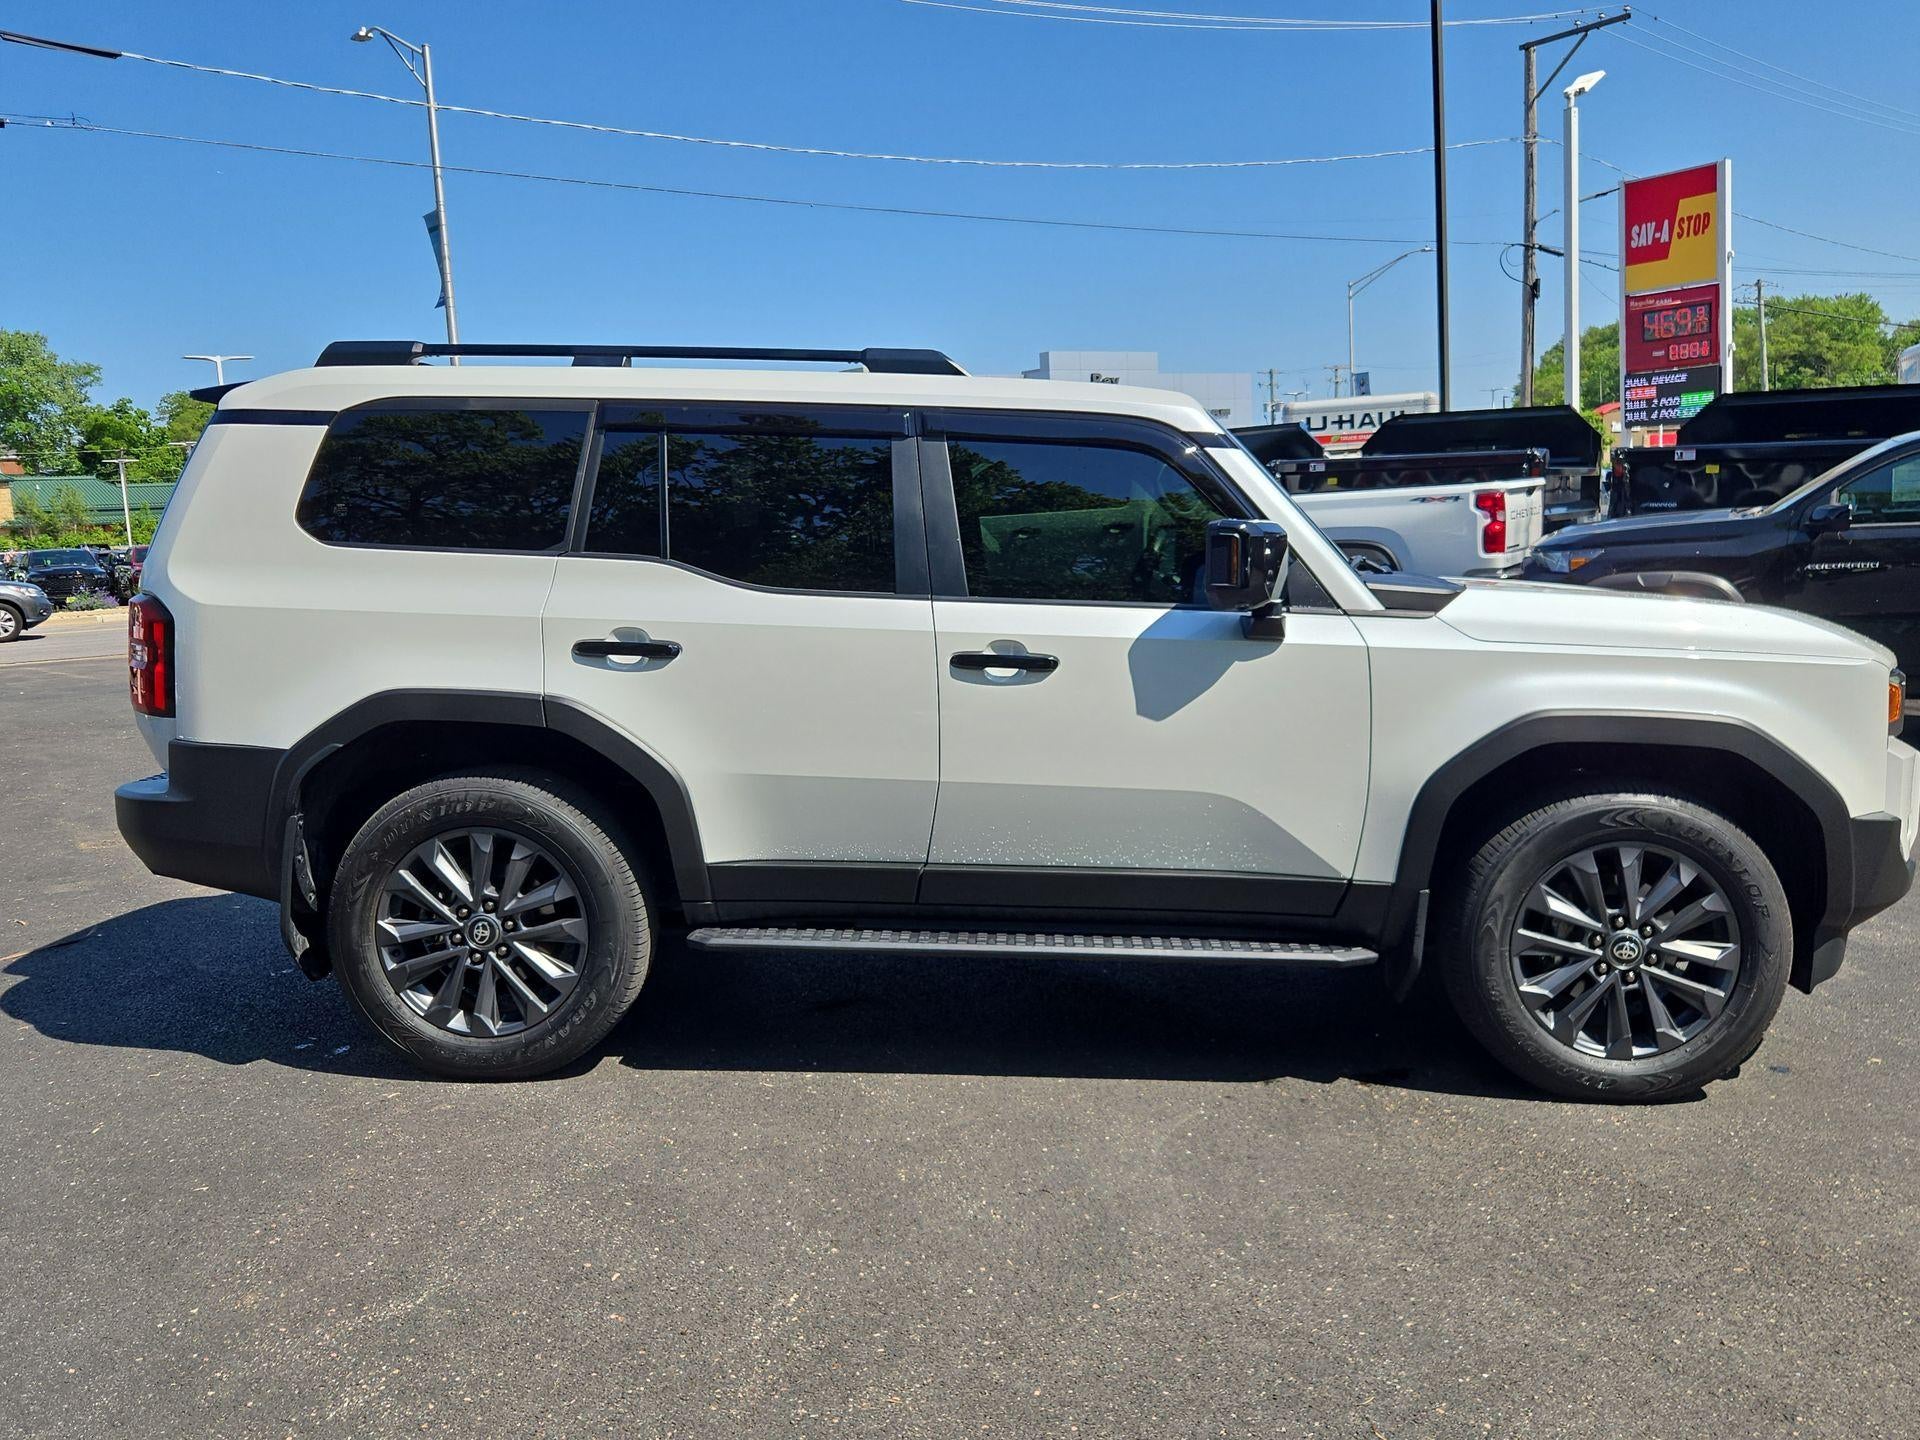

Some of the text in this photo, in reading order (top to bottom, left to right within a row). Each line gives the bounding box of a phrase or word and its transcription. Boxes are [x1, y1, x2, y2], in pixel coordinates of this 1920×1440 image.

[1631, 211, 1710, 248] SAV-A STOP
[1306, 410, 1405, 431] U-HAU
